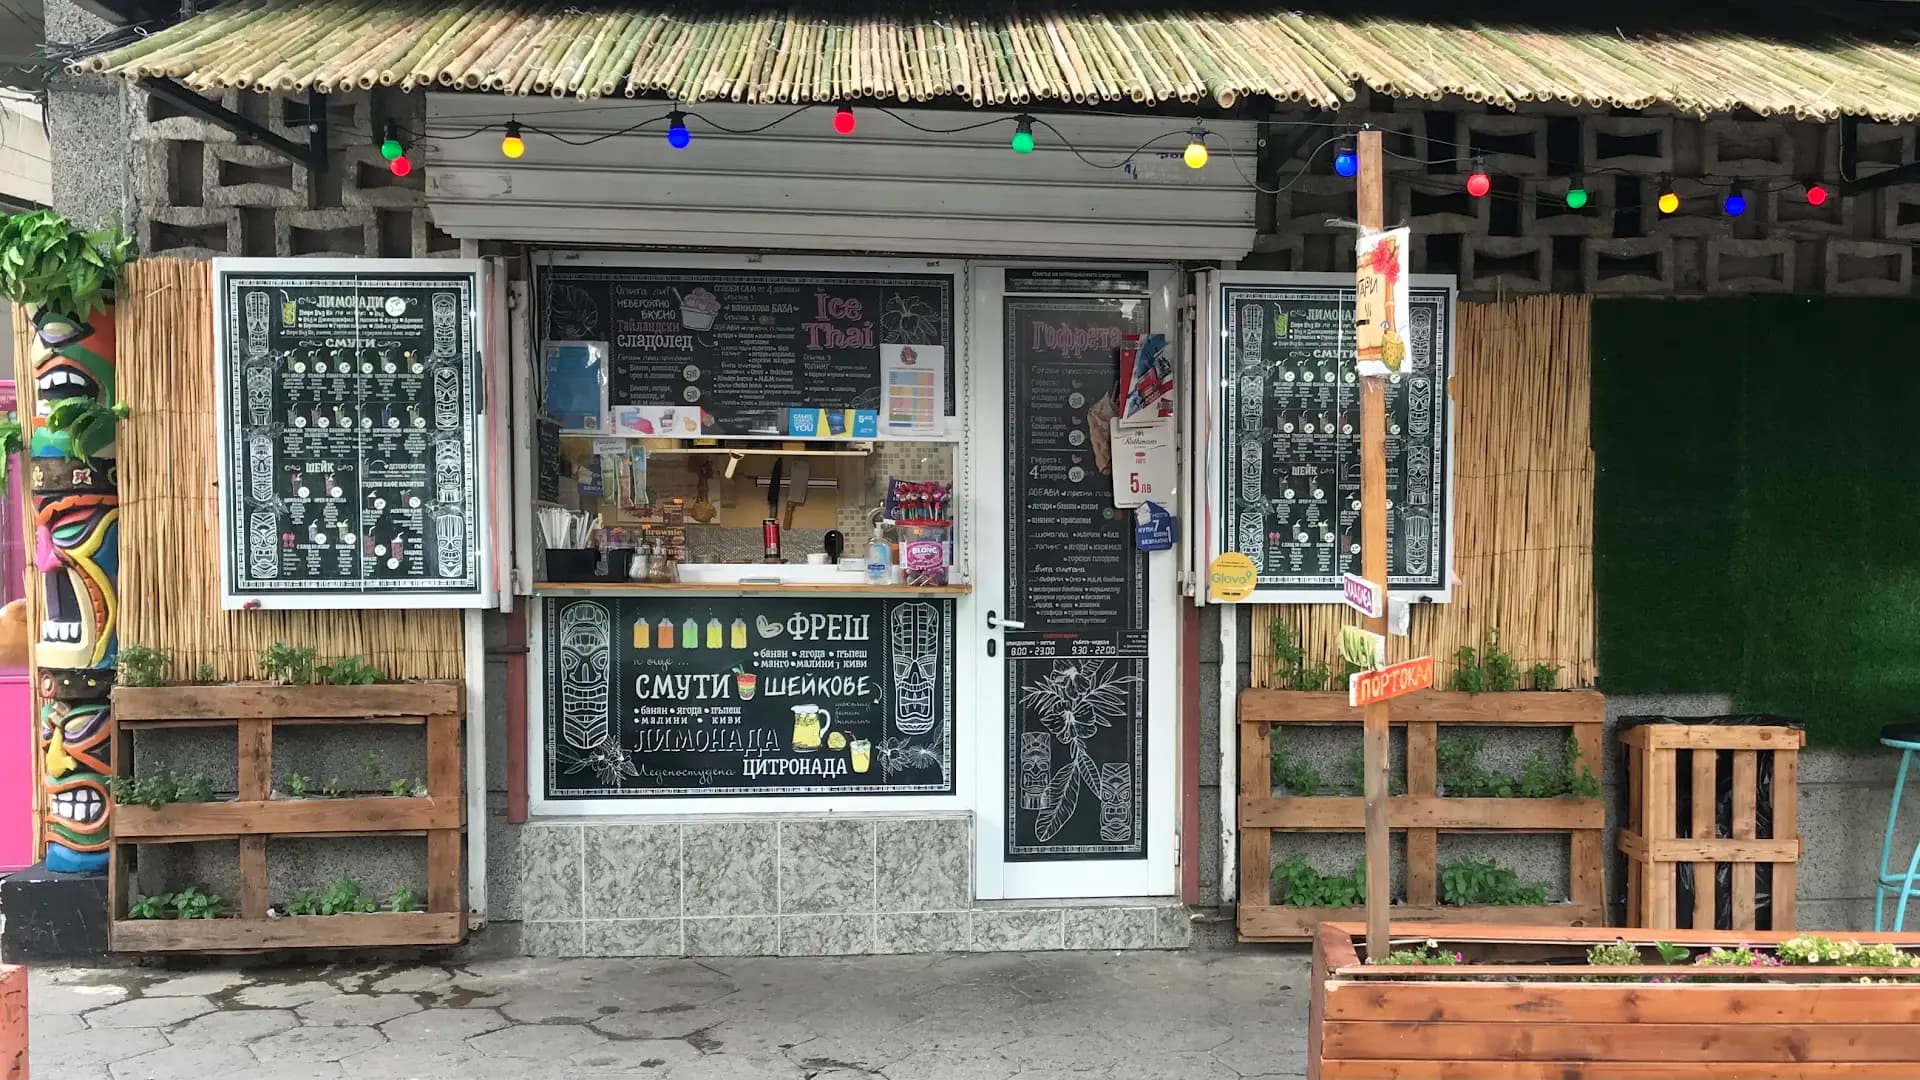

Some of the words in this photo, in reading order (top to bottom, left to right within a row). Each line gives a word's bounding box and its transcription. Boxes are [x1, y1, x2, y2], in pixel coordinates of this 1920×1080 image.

[814, 288, 863, 322] Ice
[801, 320, 877, 351] Thai
[617, 334, 694, 352] сладолед
[794, 424, 814, 432] YOU
[305, 460, 335, 473] ШЕЙК
[1029, 464, 1040, 479] 4
[1291, 463, 1318, 476] ШЕЙК
[1130, 472, 1140, 494] 5
[645, 527, 683, 537] brownie
[1153, 520, 1160, 532] 7
[1211, 572, 1247, 585] Glovo
[786, 611, 870, 641] ФРЕШ
[760, 648, 788, 658] банан
[799, 649, 826, 660] ягода
[836, 649, 868, 658] пъпеш
[760, 660, 789, 669] манго
[843, 660, 868, 669] киви
[635, 673, 731, 700] СМУТИ
[764, 672, 871, 698] ШЕЙКОВЕ
[1361, 661, 1432, 701] ПОРТОКАЛ
[640, 705, 668, 715] банан
[676, 706, 702, 717] ягода
[710, 706, 742, 715] пъпеш
[641, 716, 688, 725] малини
[711, 716, 742, 725] киви
[633, 728, 781, 758] ЛИМОНАДА
[638, 763, 737, 785] Леденостудена
[742, 757, 849, 780] ЦИТРОНАДА
